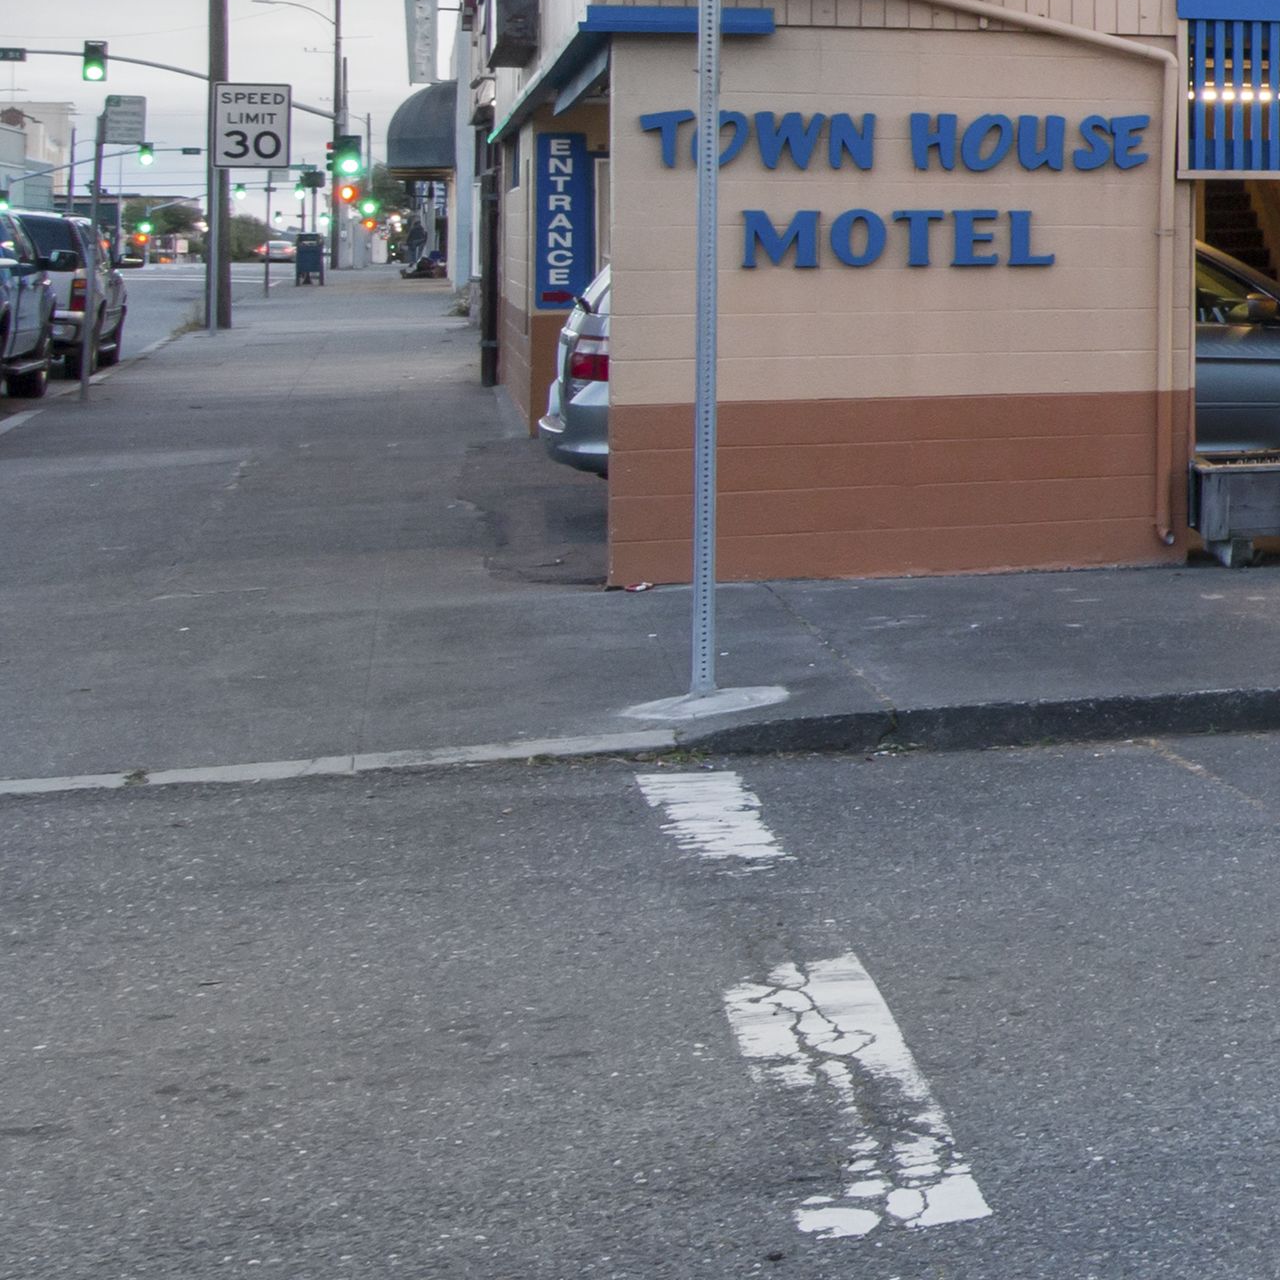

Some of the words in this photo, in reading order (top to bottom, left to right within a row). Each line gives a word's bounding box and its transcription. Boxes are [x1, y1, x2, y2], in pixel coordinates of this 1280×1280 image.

[221, 92, 285, 105] SPEED
[227, 112, 277, 125] LIMIT
[223, 130, 282, 159] 30
[640, 109, 876, 171] TOWN
[909, 113, 1151, 172] HOUSE
[547, 139, 574, 285] ENTRANCE
[741, 209, 1055, 268] MOTEL
